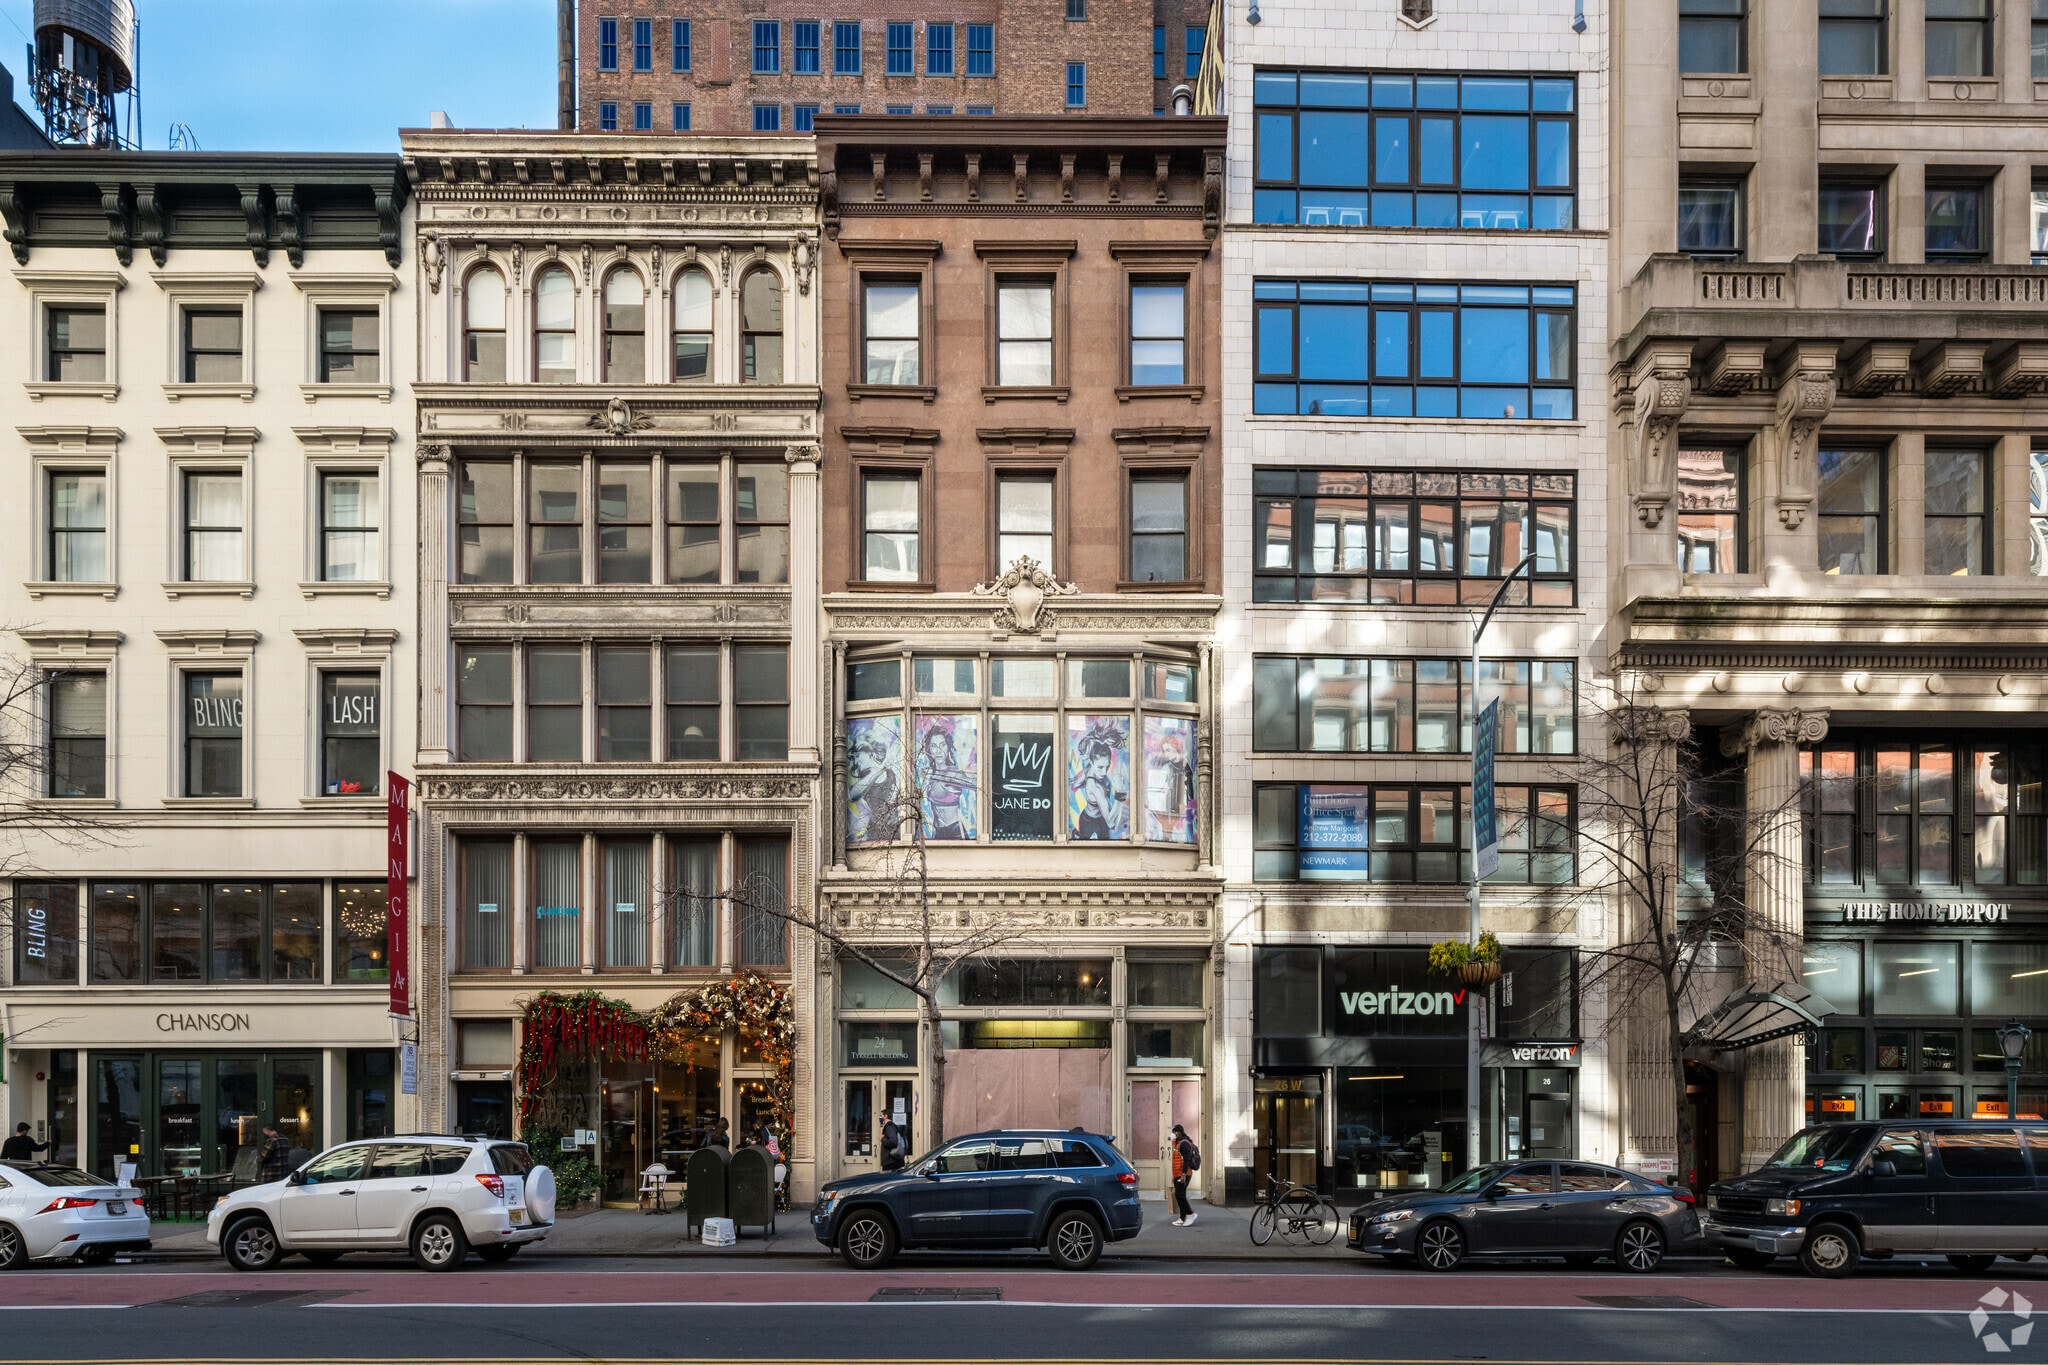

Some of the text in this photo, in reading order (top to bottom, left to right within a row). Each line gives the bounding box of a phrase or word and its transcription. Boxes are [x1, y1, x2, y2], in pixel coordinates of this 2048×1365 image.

[193, 697, 243, 727] BLING
[333, 695, 375, 724] LASH
[994, 797, 1051, 810] JANE DO
[1304, 794, 1350, 805] Full Floor
[1303, 806, 1362, 820] Office Space
[1303, 824, 1329, 832] Andrew
[1303, 832, 1363, 842] 212-372-2080
[1302, 856, 1348, 865] NEWMARK
[391, 783, 406, 990] MANGIA
[1842, 902, 2012, 921] THE HOME DEPOT
[27, 907, 46, 958] BLING
[1339, 984, 1455, 1016] verizon
[156, 1012, 250, 1033] CHANSON
[874, 1036, 886, 1049] 24
[1511, 1044, 1571, 1062] verizon
[1831, 1102, 1846, 1110] Exit
[1929, 1102, 1943, 1111] Exit
[1986, 1103, 2000, 1112] Exit
[588, 1131, 595, 1141] A
